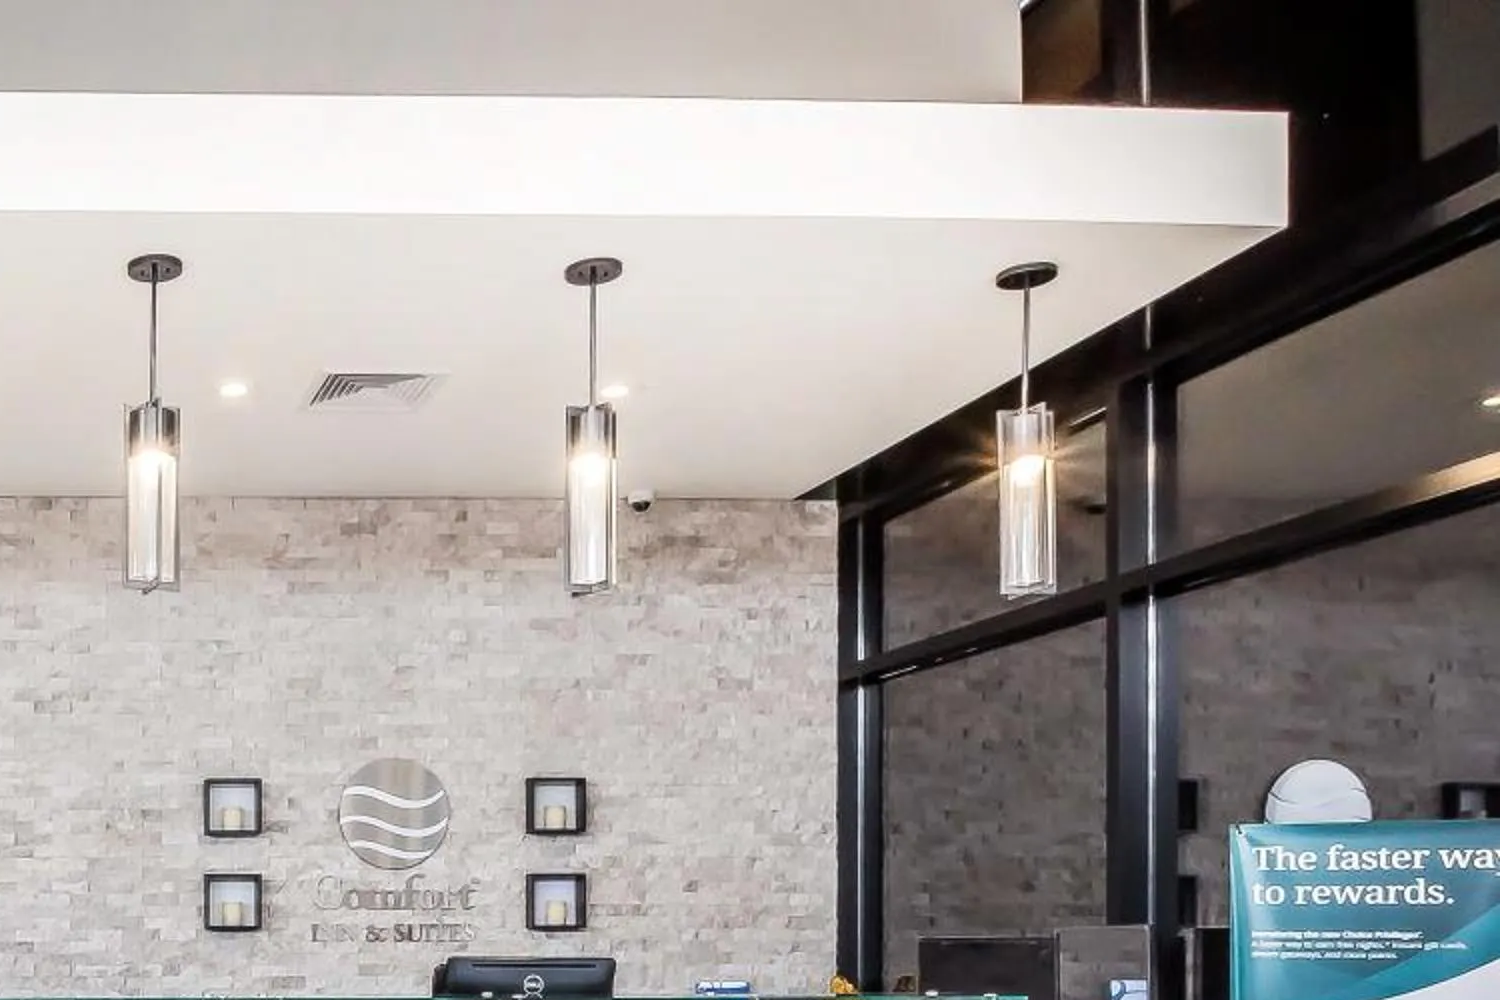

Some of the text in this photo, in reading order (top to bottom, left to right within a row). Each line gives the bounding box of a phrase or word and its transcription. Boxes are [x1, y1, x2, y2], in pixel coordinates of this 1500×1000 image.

[1251, 845, 1317, 871] The
[1326, 844, 1430, 871] faster
[313, 873, 477, 911] Comfort
[1251, 877, 1455, 905] to rewards.
